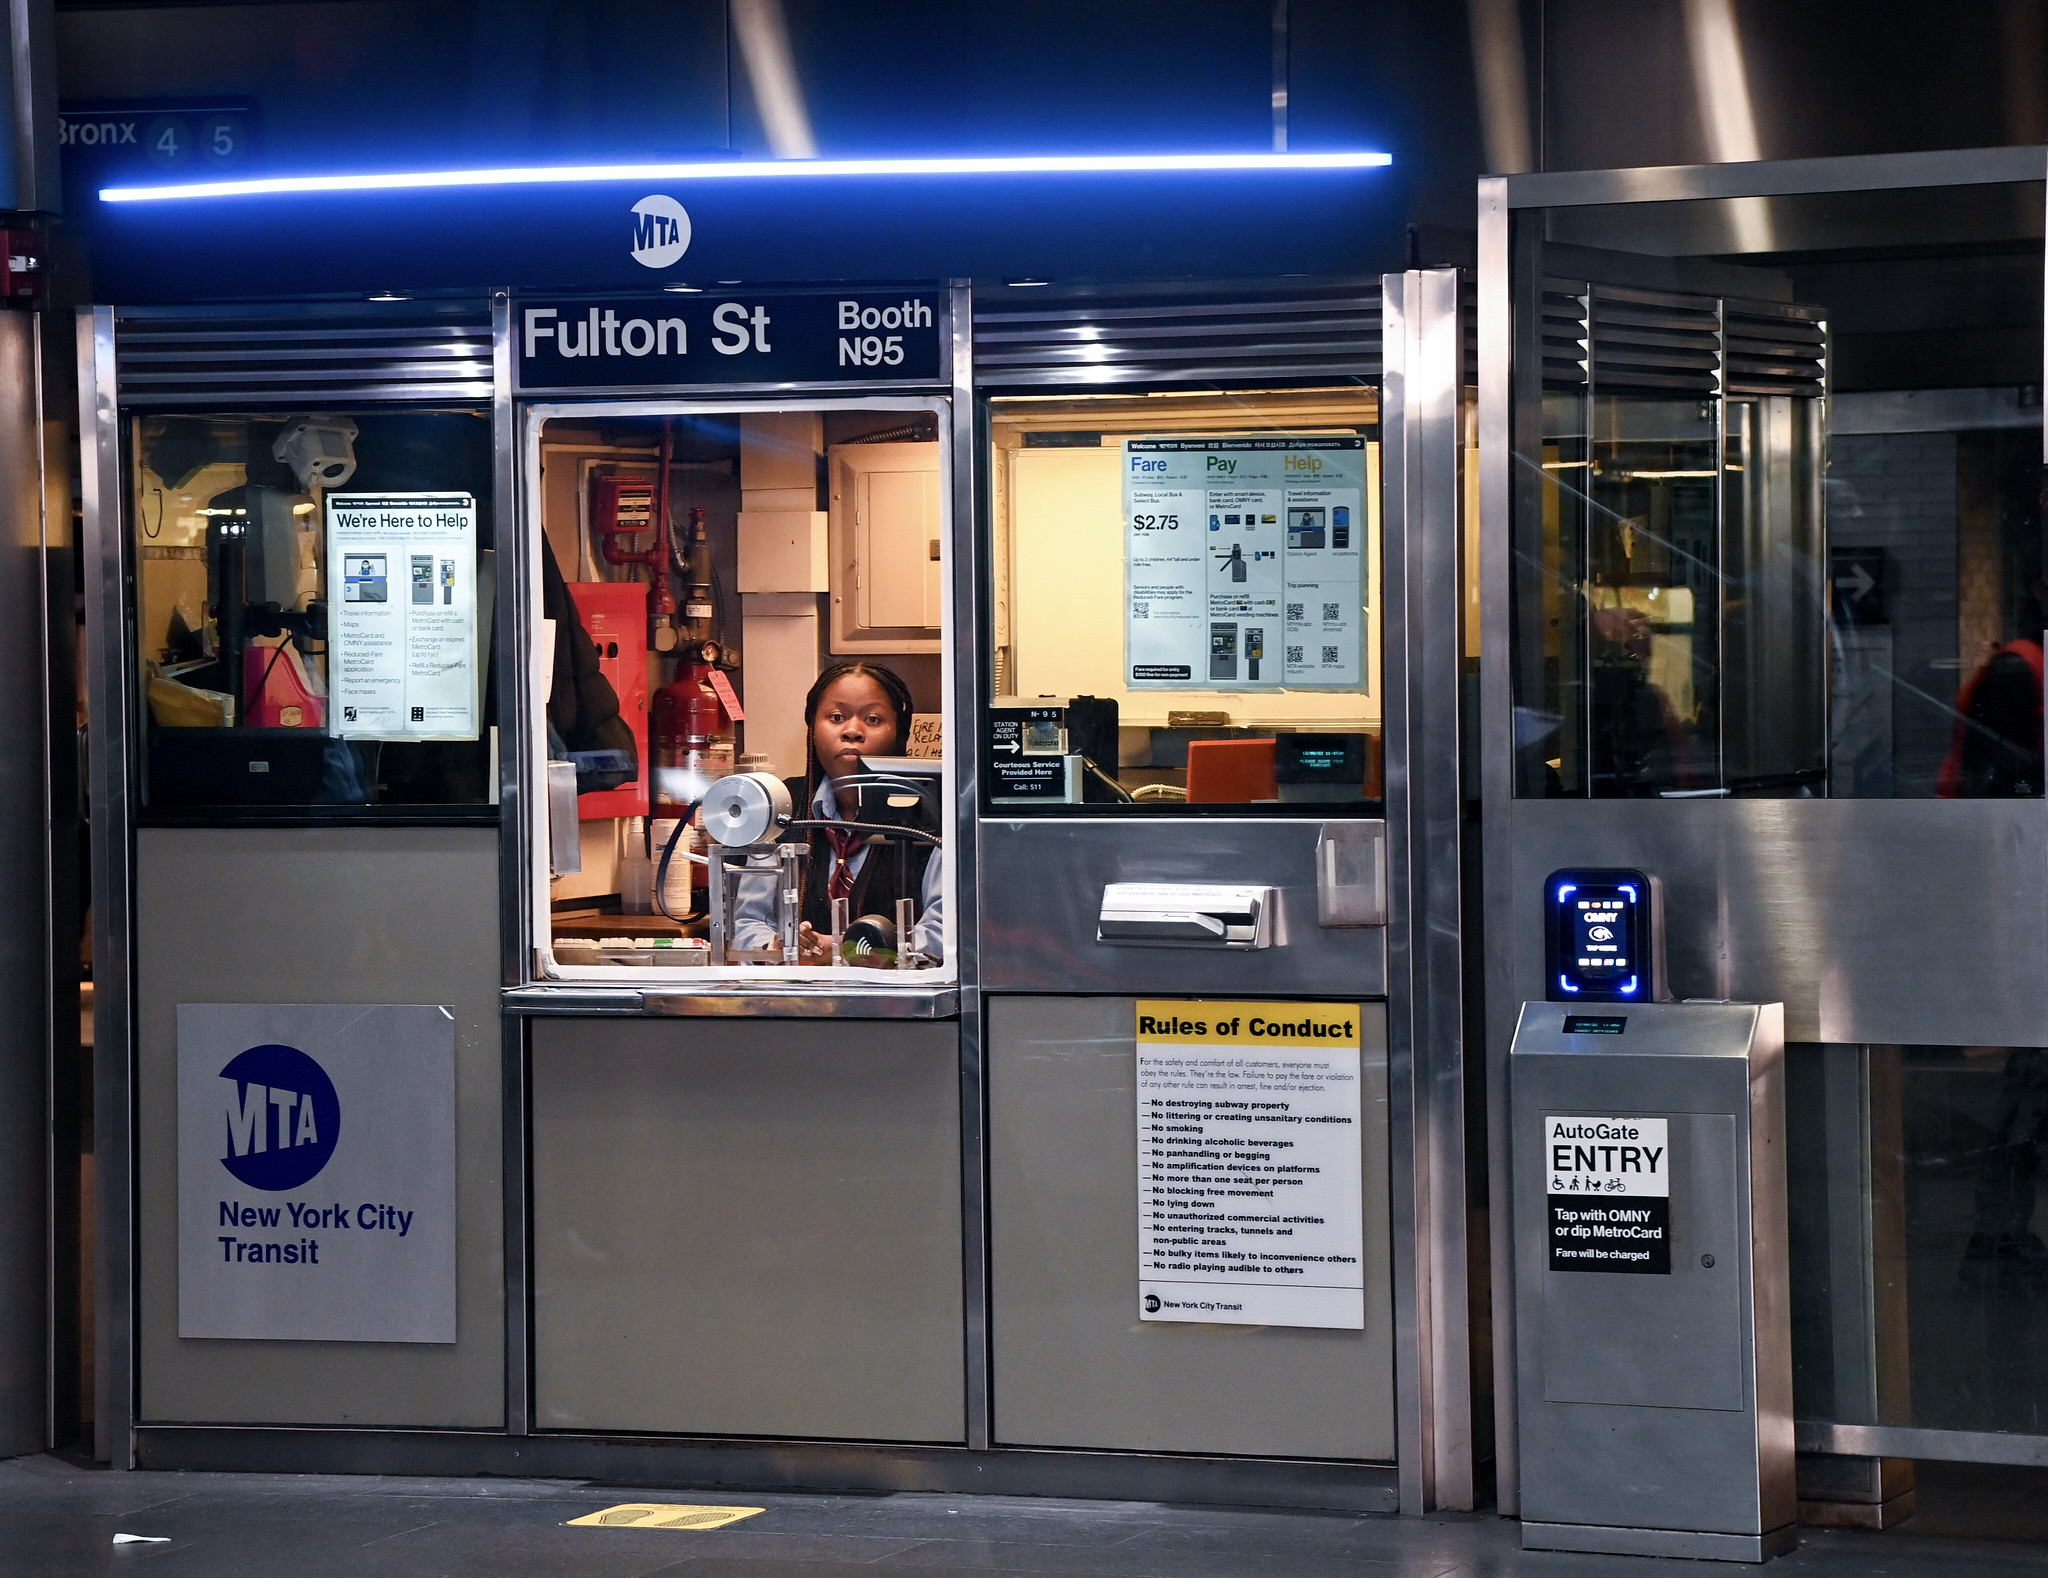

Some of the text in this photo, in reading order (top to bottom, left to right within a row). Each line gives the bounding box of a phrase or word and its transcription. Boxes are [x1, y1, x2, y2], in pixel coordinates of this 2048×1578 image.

[156, 128, 178, 156] 4
[212, 126, 233, 156] 5
[838, 299, 932, 329] Booth
[525, 302, 771, 357] Fulton St
[839, 336, 904, 366] N95
[1132, 457, 1167, 472] Fare
[1207, 456, 1237, 474] Pay
[1284, 456, 1322, 473] Help
[336, 513, 468, 530] We're Here to Help
[1133, 514, 1179, 531] $2.75
[913, 719, 934, 735] FIRE
[1584, 912, 1618, 923] OMNY
[1140, 1016, 1353, 1038] Rules of Conduct
[1140, 1057, 1152, 1066] For
[1153, 1058, 1164, 1066] the
[1165, 1058, 1184, 1068] safety
[1185, 1058, 1198, 1067] and
[1199, 1058, 1225, 1067] comfort
[1226, 1059, 1234, 1067] of
[1235, 1059, 1244, 1068] all
[1245, 1061, 1281, 1069] customers,
[1282, 1062, 1312, 1070] everyone
[1140, 1069, 1157, 1078] obey
[1158, 1069, 1169, 1077] the
[1170, 1069, 1188, 1078] rules.
[1189, 1069, 1214, 1080] They're
[1215, 1070, 1226, 1078] the
[1242, 1070, 1266, 1079] Failure
[1289, 1071, 1300, 1080] the
[1301, 1071, 1315, 1080] fare
[1325, 1072, 1354, 1081] violation
[1151, 1099, 1290, 1111] No destroying subway property
[1166, 1112, 1201, 1122] littering
[1215, 1113, 1252, 1123] creating
[1254, 1114, 1303, 1124] unsanitary
[1304, 1115, 1352, 1124] conditions
[1151, 1124, 1204, 1134] No smoking
[1553, 1123, 1639, 1140] AutoGate
[1152, 1136, 1294, 1149] No drinking alcoholic beverages
[1152, 1149, 1164, 1157] No
[1166, 1149, 1221, 1160] panhandling
[1234, 1151, 1270, 1161] begging
[1553, 1145, 1664, 1173] ENTRY
[1152, 1161, 1164, 1169] No
[1166, 1162, 1225, 1172] amplification
[1227, 1163, 1261, 1174] devices
[1277, 1165, 1320, 1175] platforms
[1152, 1174, 1165, 1182] No
[1192, 1175, 1212, 1183] than
[1233, 1176, 1253, 1185] seat
[1255, 1178, 1270, 1186] per
[1272, 1179, 1303, 1187] person
[1152, 1186, 1274, 1197] No blocking free movement
[1152, 1199, 1215, 1209] No lying down
[219, 1201, 414, 1237] New York City
[1153, 1211, 1325, 1224] No unauthorized commercial activities
[1554, 1208, 1651, 1222] Tap with OMNY
[1153, 1224, 1293, 1236] No entering tracks, tunnels and
[1555, 1224, 1662, 1239] or dip MetroCard
[1153, 1236, 1199, 1246] non-public
[218, 1236, 319, 1264] Transit
[1153, 1249, 1357, 1263] No bulky items likely to inconvenience others
[1556, 1248, 1650, 1262] Fare will be charged
[1154, 1261, 1166, 1269] No
[1168, 1262, 1191, 1270] radio
[1193, 1263, 1226, 1273] playing
[1228, 1264, 1261, 1273] audible
[1274, 1266, 1304, 1274] others
[1181, 1301, 1199, 1309] York
[1199, 1302, 1215, 1311] City
[1215, 1302, 1242, 1311] Transit
